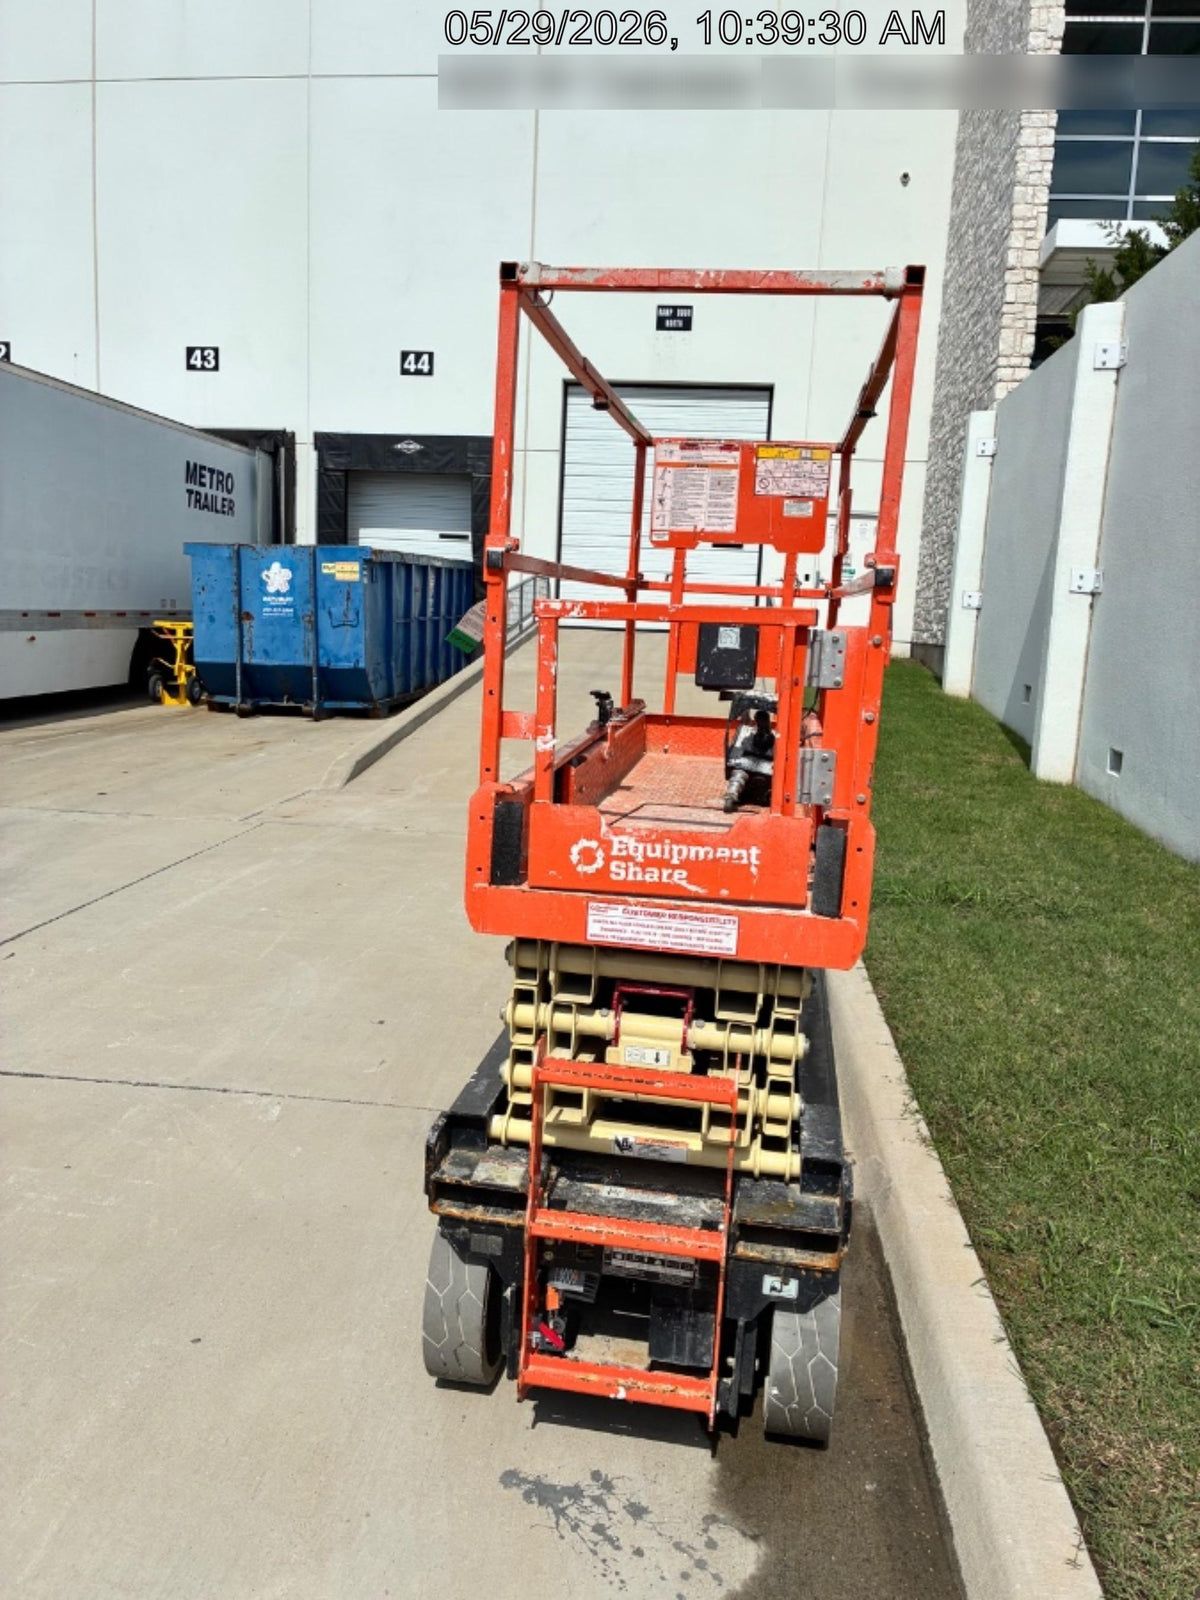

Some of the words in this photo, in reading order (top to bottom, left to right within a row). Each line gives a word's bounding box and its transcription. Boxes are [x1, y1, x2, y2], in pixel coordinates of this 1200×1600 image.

[190, 349, 216, 369] 43
[403, 353, 431, 373] 44
[185, 460, 234, 495] METRO
[186, 488, 236, 518] TRAILER
[609, 835, 762, 865] Equipment
[609, 860, 689, 884] Share
